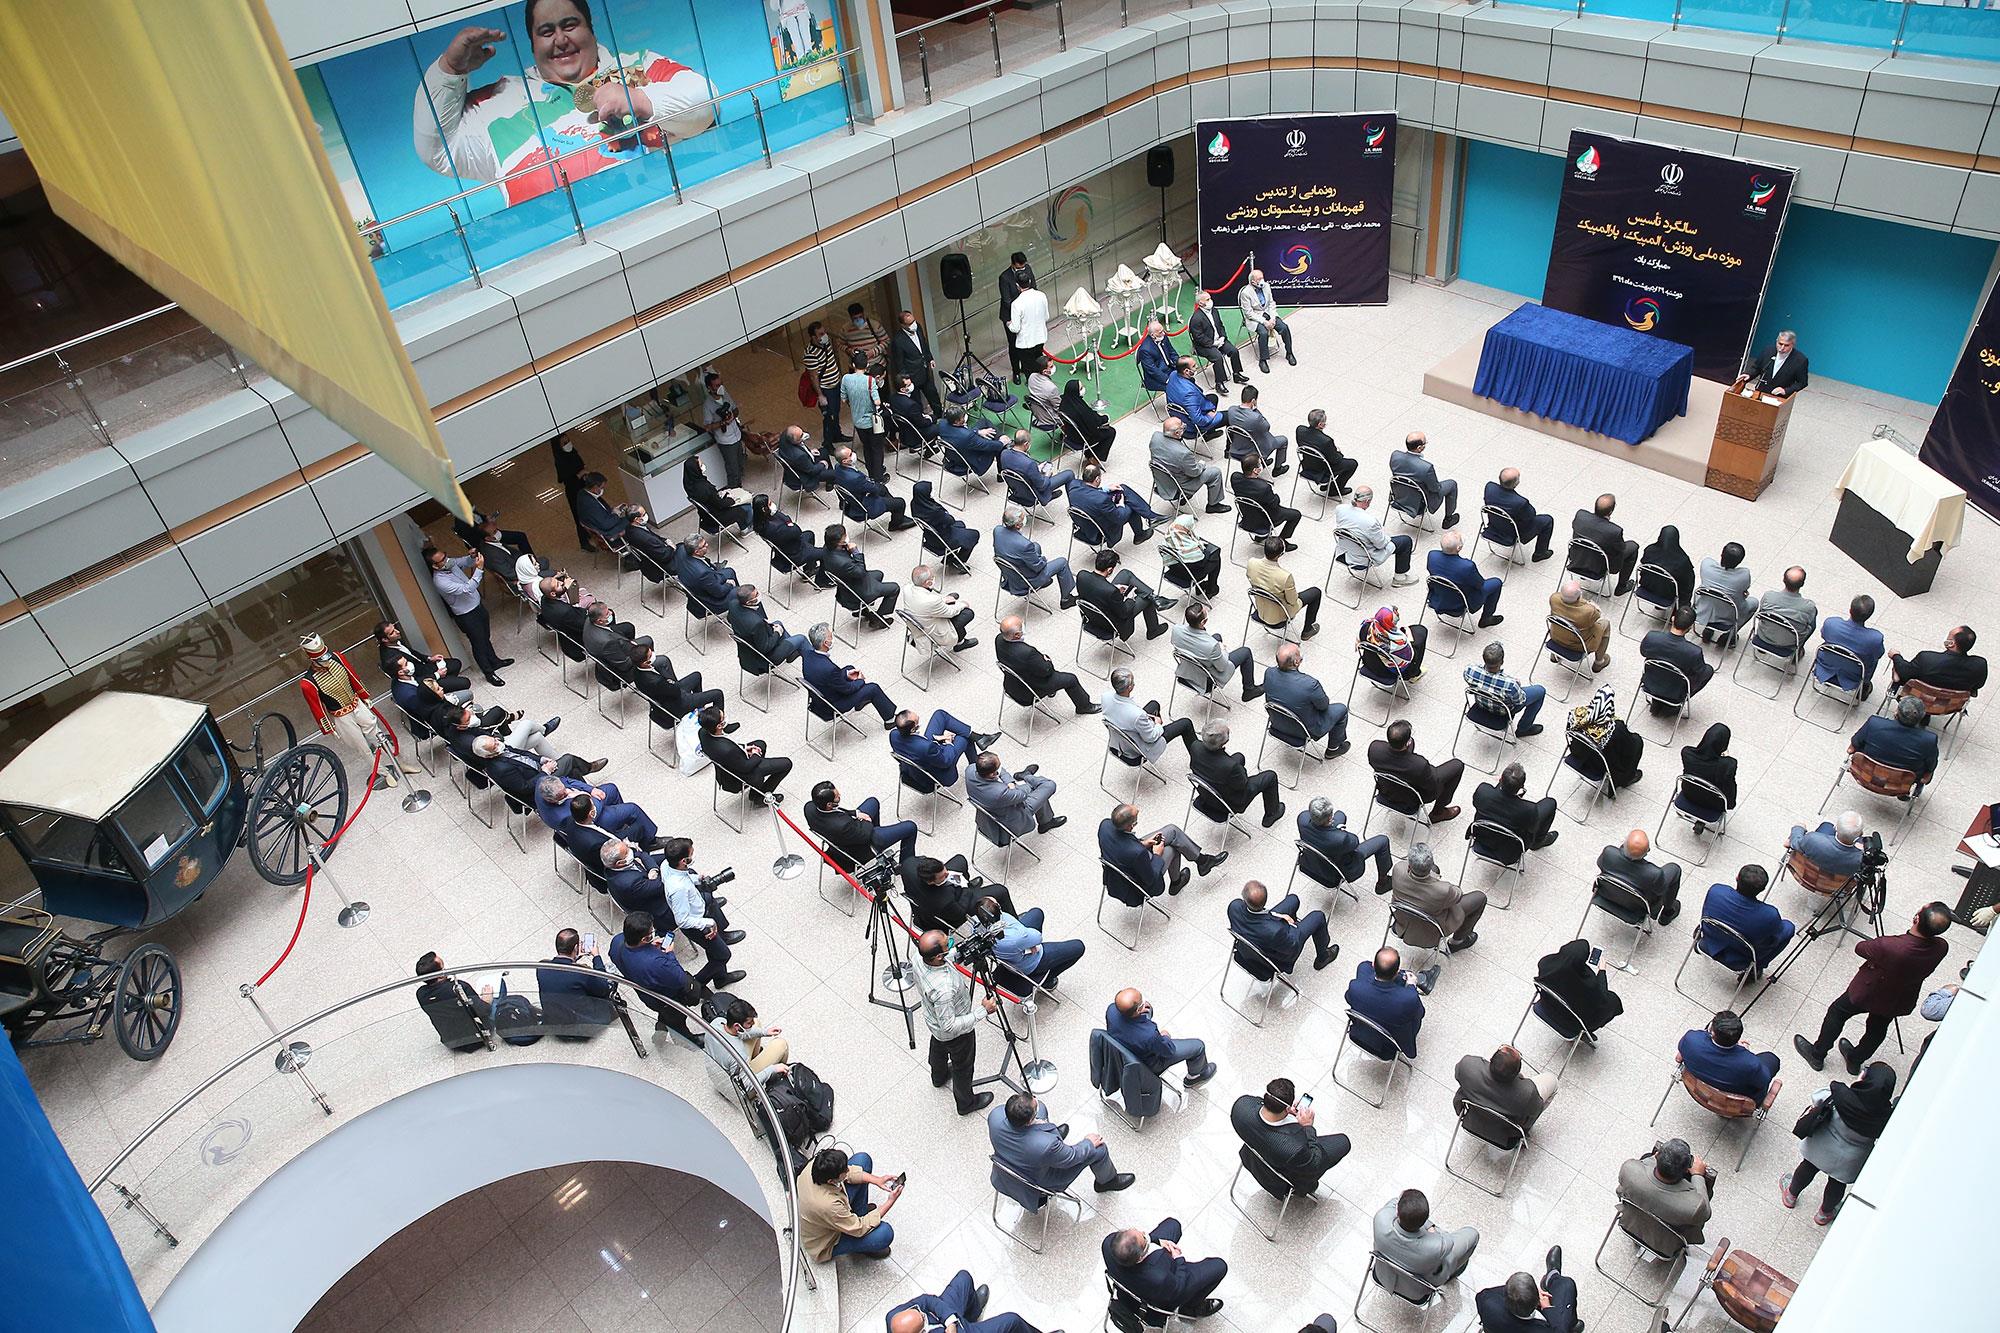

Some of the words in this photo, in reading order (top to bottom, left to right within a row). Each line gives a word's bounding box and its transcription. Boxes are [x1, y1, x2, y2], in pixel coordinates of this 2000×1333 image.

[1255, 187, 1288, 201] تندیس
[1288, 185, 1297, 199] از
[1299, 185, 1337, 200] رونمایی
[1226, 205, 1258, 220] ورزشی
[1260, 204, 1312, 218] پیشکسوتان
[1313, 205, 1320, 216] و
[1322, 201, 1365, 216] قهرمانان
[1577, 219, 1620, 240] پارالمپیک
[1663, 218, 1698, 235] سالگرد
[1692, 247, 1719, 261] ملی
[1719, 252, 1742, 269] موزه
